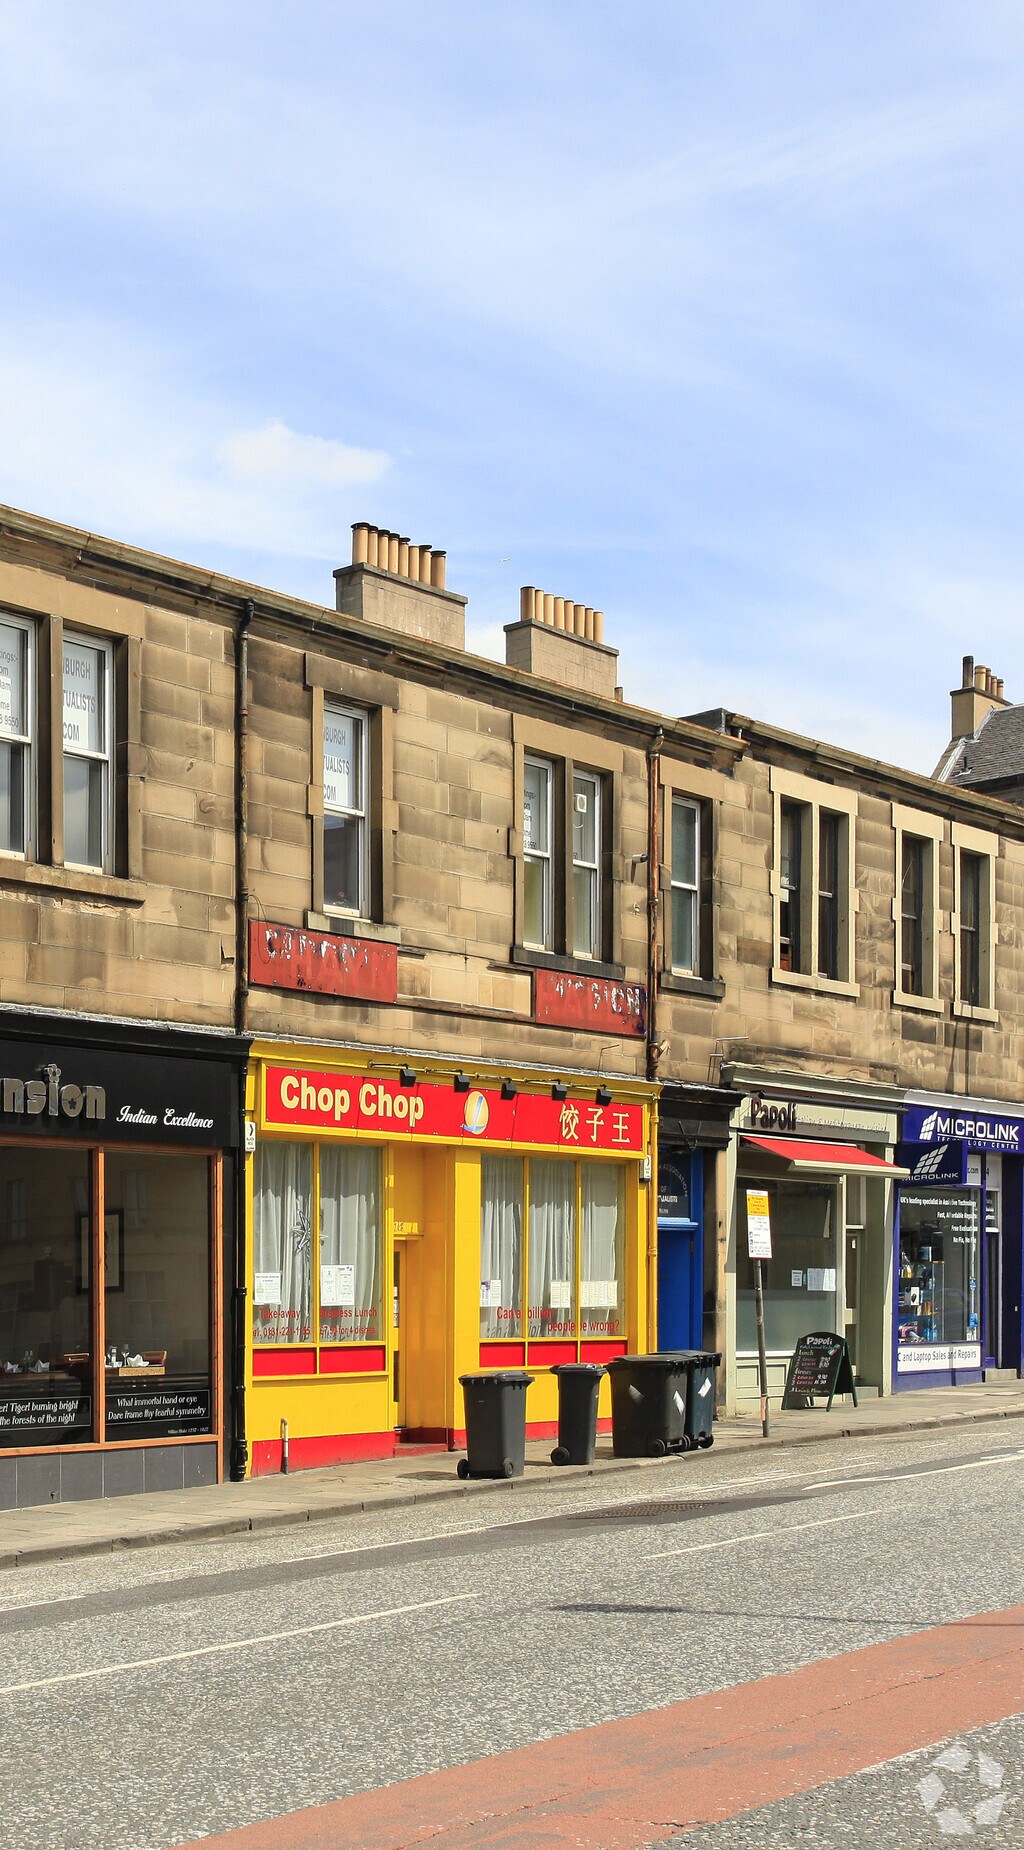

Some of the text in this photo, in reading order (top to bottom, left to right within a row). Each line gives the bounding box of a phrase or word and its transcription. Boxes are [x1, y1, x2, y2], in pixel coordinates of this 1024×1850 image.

[63, 657, 91, 680] BURGH
[323, 726, 346, 746] BURGH
[280, 1075, 425, 1127] Chop Chop
[116, 1105, 214, 1129] Indian Excellence
[751, 1097, 796, 1131] Papoli
[559, 1103, 631, 1143] 饺子王
[937, 1116, 1019, 1141] MICROLINK
[937, 1136, 1019, 1151] TECLOGY CENTRE
[259, 1307, 301, 1320] Take-away
[355, 1307, 377, 1318] Lunch
[497, 1306, 514, 1319] Can
[516, 1310, 522, 1319] a
[547, 1320, 576, 1333] people
[590, 1319, 620, 1334] wrong?
[807, 1336, 833, 1345] Papoli
[902, 1352, 912, 1362] and
[913, 1352, 931, 1363] Laptop
[932, 1350, 946, 1361] Sales
[947, 1350, 956, 1360] and
[958, 1348, 977, 1360] Repairs
[10, 1402, 31, 1414] Tiger!
[31, 1401, 57, 1412] burning
[58, 1400, 79, 1411] bright
[117, 1398, 133, 1407] What
[134, 1396, 162, 1406] immortal
[162, 1395, 178, 1404] hand
[186, 1396, 197, 1405] eye
[0, 1416, 11, 1425] the
[12, 1415, 36, 1425] forests
[37, 1414, 45, 1424] of
[46, 1414, 57, 1423] the
[58, 1413, 76, 1424] night
[108, 1406, 206, 1420] Dare frame thy fearful symmetry
